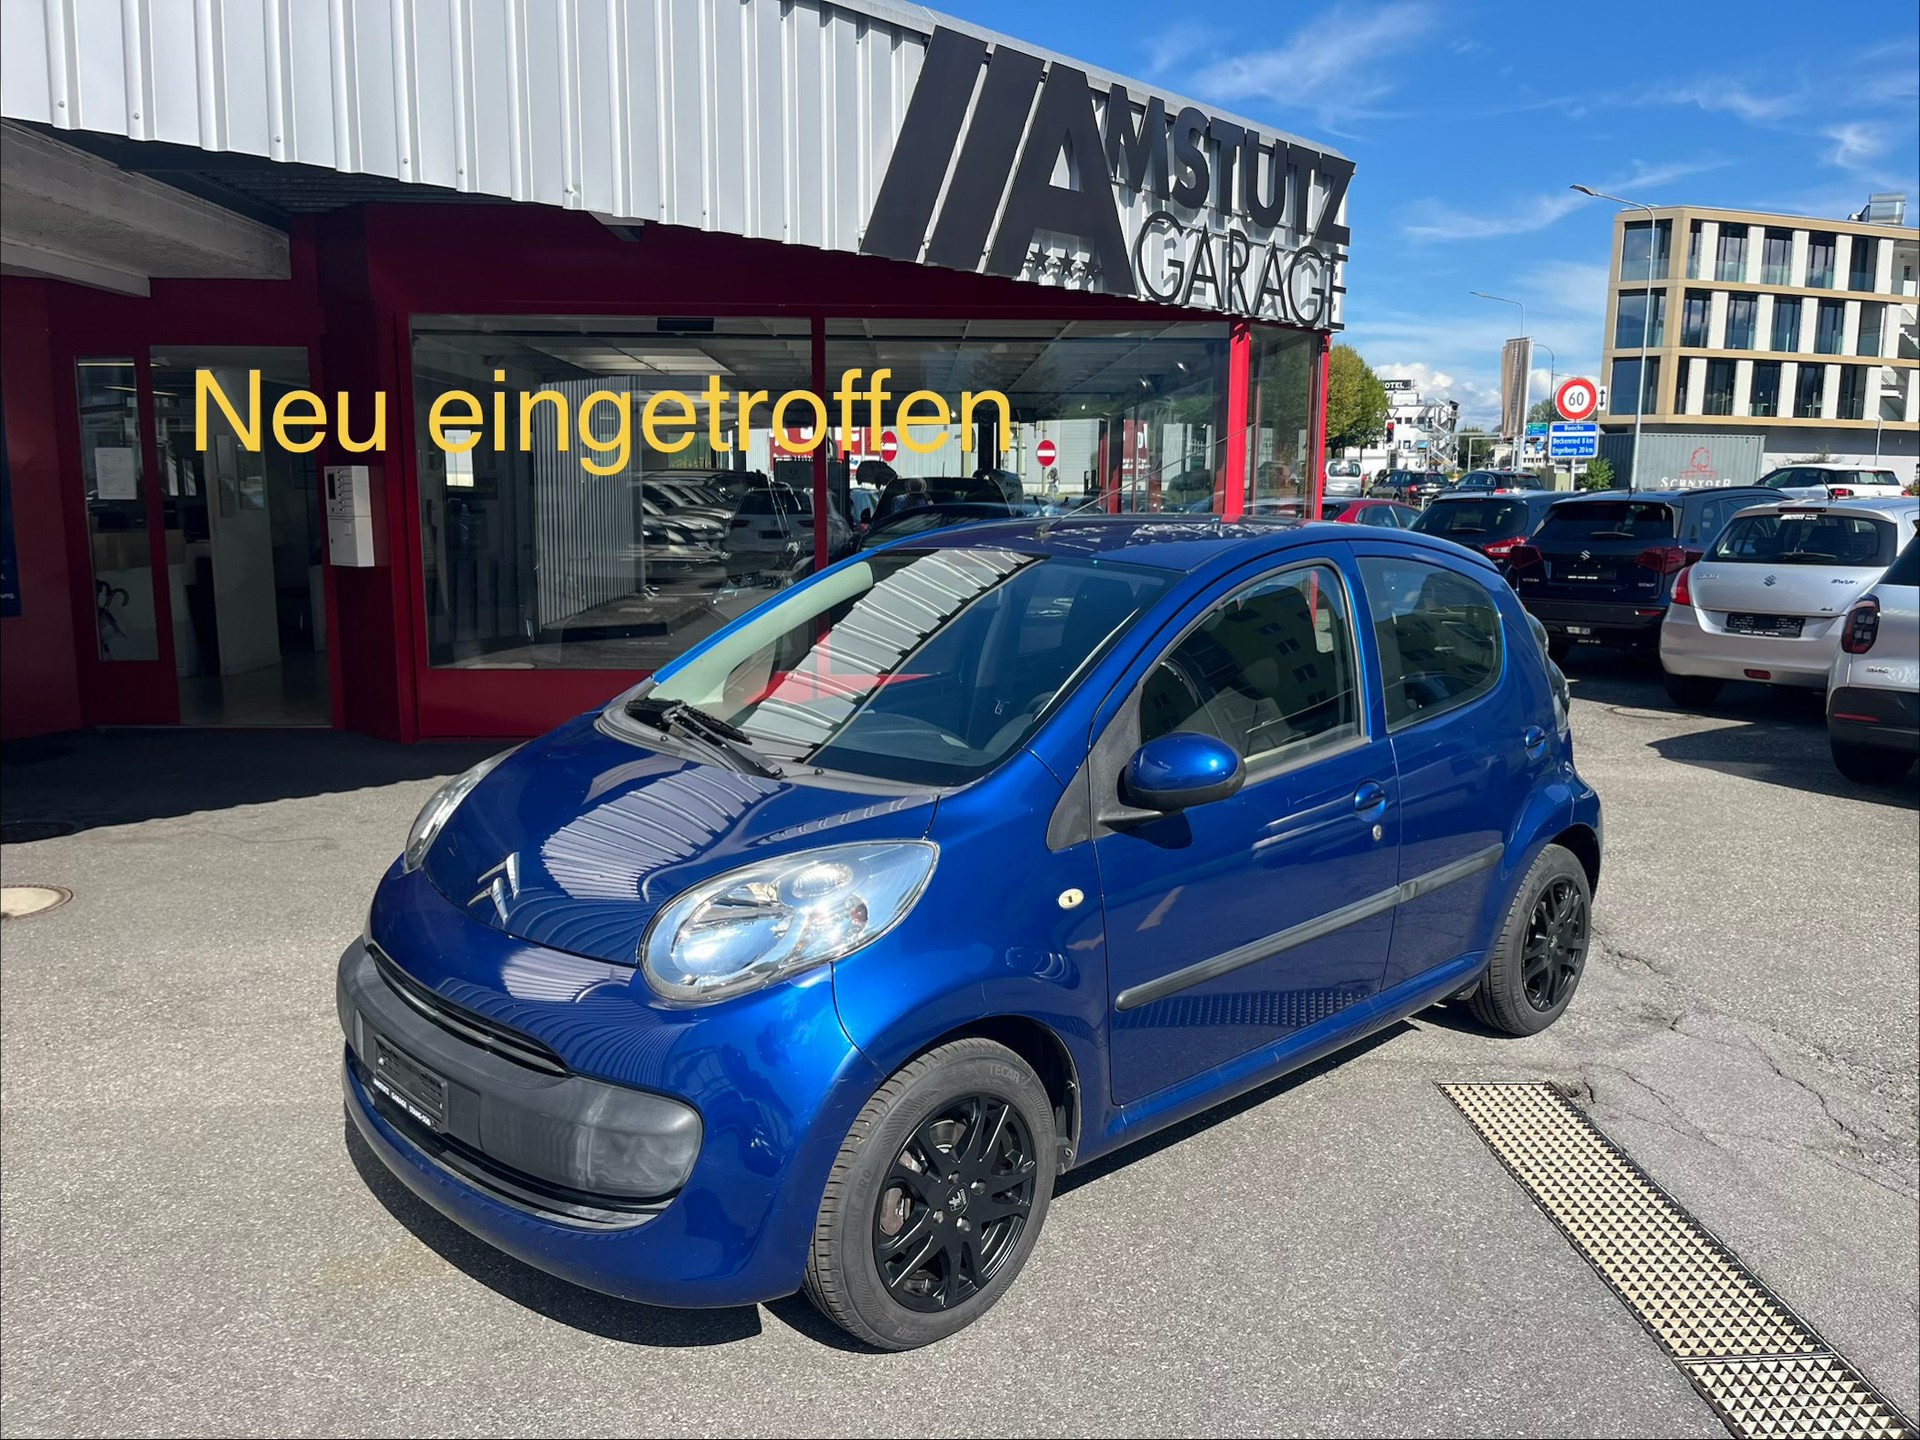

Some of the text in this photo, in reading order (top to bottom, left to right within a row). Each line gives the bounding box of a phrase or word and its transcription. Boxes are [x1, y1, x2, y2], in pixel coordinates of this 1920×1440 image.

[985, 62, 1357, 297] AMSTUTZ
[1137, 211, 1348, 331] GARAGE
[1568, 391, 1585, 407] 60
[1552, 437, 1581, 445] Beckenried
[1586, 437, 1594, 445] km
[1552, 446, 1594, 455] Engelberg 20 km
[987, 1062, 1021, 1085] TECAR
[855, 1169, 873, 1198] PRO
